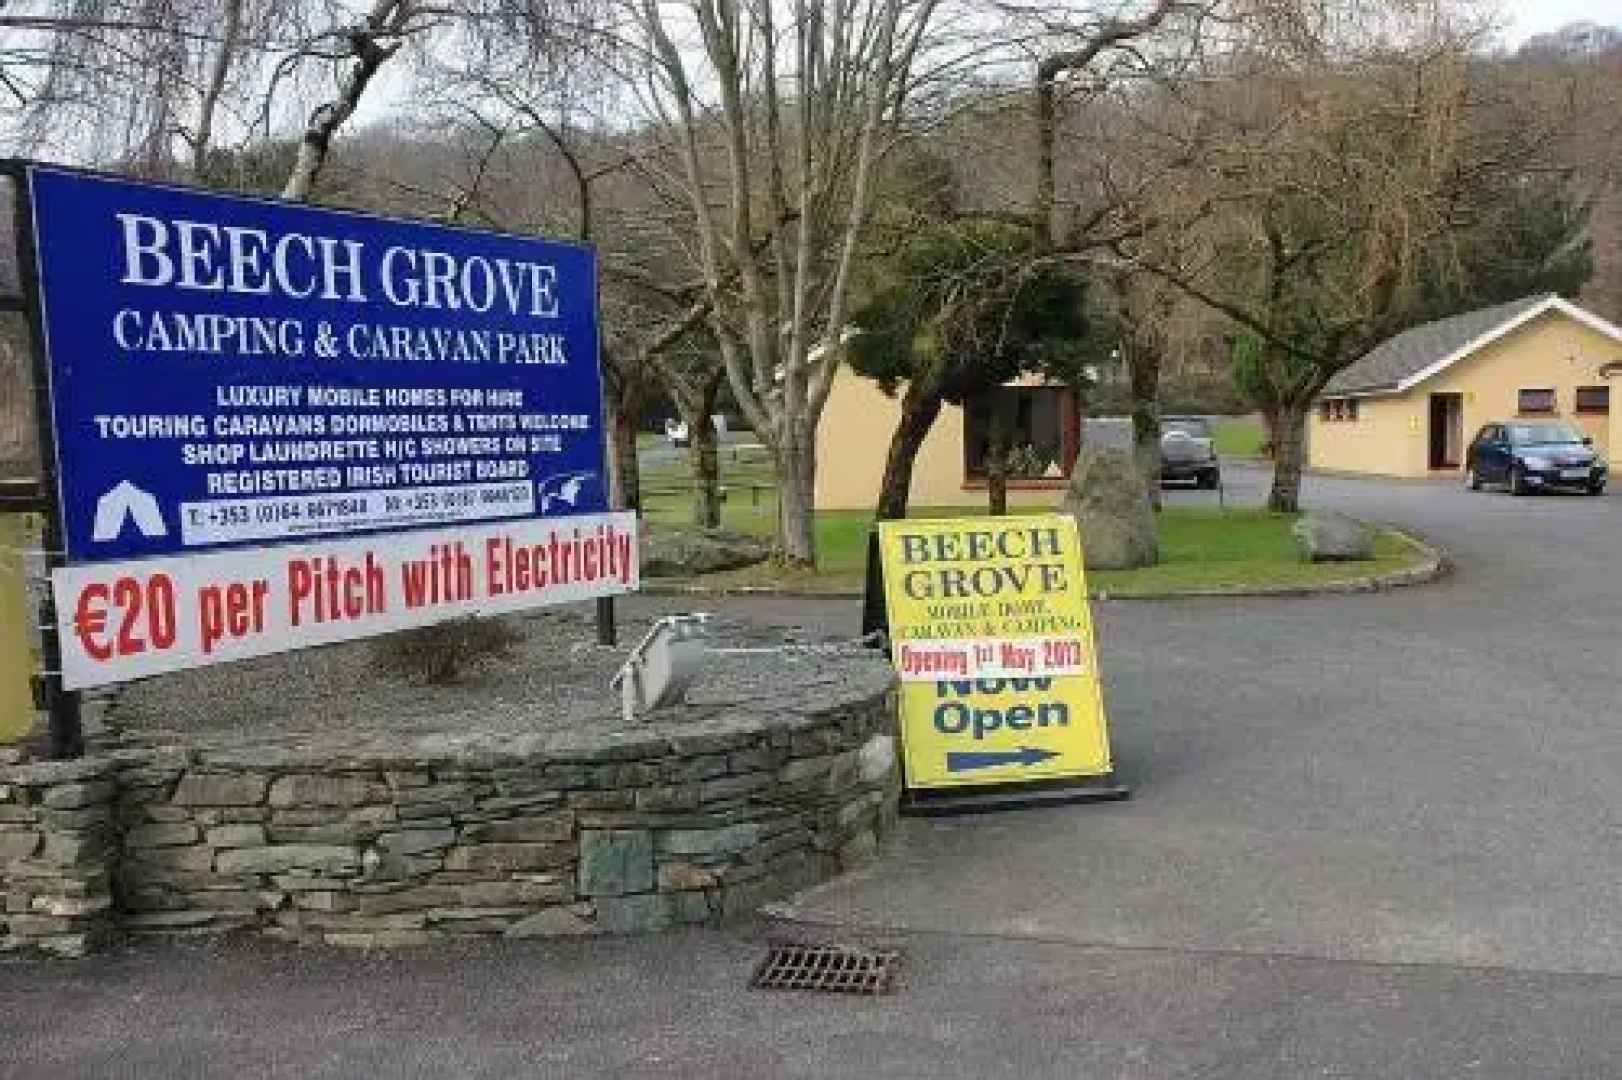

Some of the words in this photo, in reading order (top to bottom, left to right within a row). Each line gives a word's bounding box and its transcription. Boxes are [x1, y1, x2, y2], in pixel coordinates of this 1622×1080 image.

[116, 213, 367, 301] BEECH
[382, 246, 559, 318] GROVE
[113, 307, 304, 357] CAMPING
[314, 321, 339, 358] &
[347, 323, 491, 362] CARAVAN
[498, 333, 568, 364] PARK
[216, 386, 302, 406] LUXURY
[308, 388, 380, 406] MOBILE
[386, 388, 448, 406] HOMES
[450, 389, 485, 406] FOR
[486, 389, 523, 406] HIRE
[94, 415, 208, 438] TOURING
[213, 415, 325, 435] CARAVANS
[330, 415, 449, 433] DORMOBILES
[467, 415, 517, 431] TENTS
[519, 415, 591, 429] WELCOME
[181, 444, 245, 465] SHOP
[249, 440, 377, 462] LAUNDRETTE
[421, 437, 501, 455] SHOWERS
[506, 437, 527, 453] ON
[531, 435, 562, 452] SITE
[206, 469, 342, 494] REGISTERED
[346, 465, 397, 486] IRISH
[399, 463, 471, 482] TOURIST
[476, 460, 530, 479] BOARD
[208, 504, 249, 526] +353
[902, 528, 1064, 564] BEECH
[74, 574, 177, 660] €20
[199, 578, 268, 653] per
[288, 551, 385, 626] Pitch
[402, 541, 472, 608] with
[486, 525, 631, 597] Electricity
[905, 564, 1067, 600] GROVE
[902, 645, 967, 675] Opening
[1001, 642, 1035, 673] May
[933, 703, 1068, 739] Open
